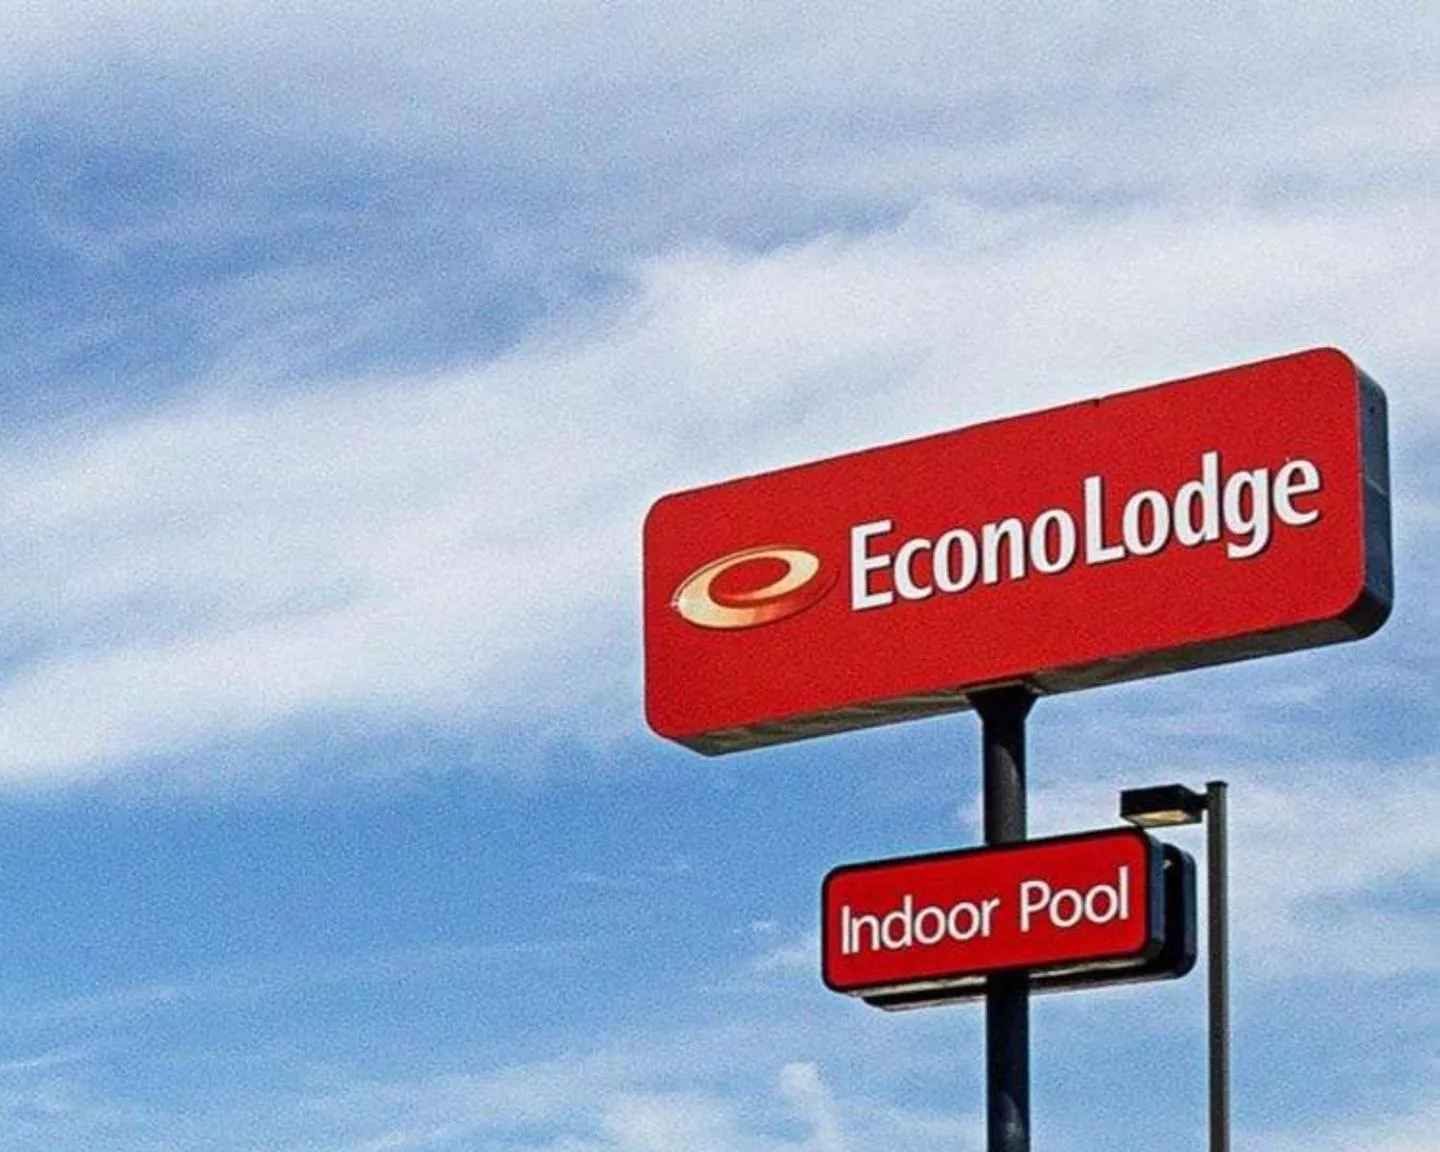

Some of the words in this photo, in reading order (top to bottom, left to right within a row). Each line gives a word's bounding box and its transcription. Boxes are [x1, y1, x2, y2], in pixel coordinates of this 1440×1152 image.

[850, 451, 1321, 612] EconoLodge
[841, 896, 1000, 954] Indoor
[1020, 866, 1129, 932] Pool
